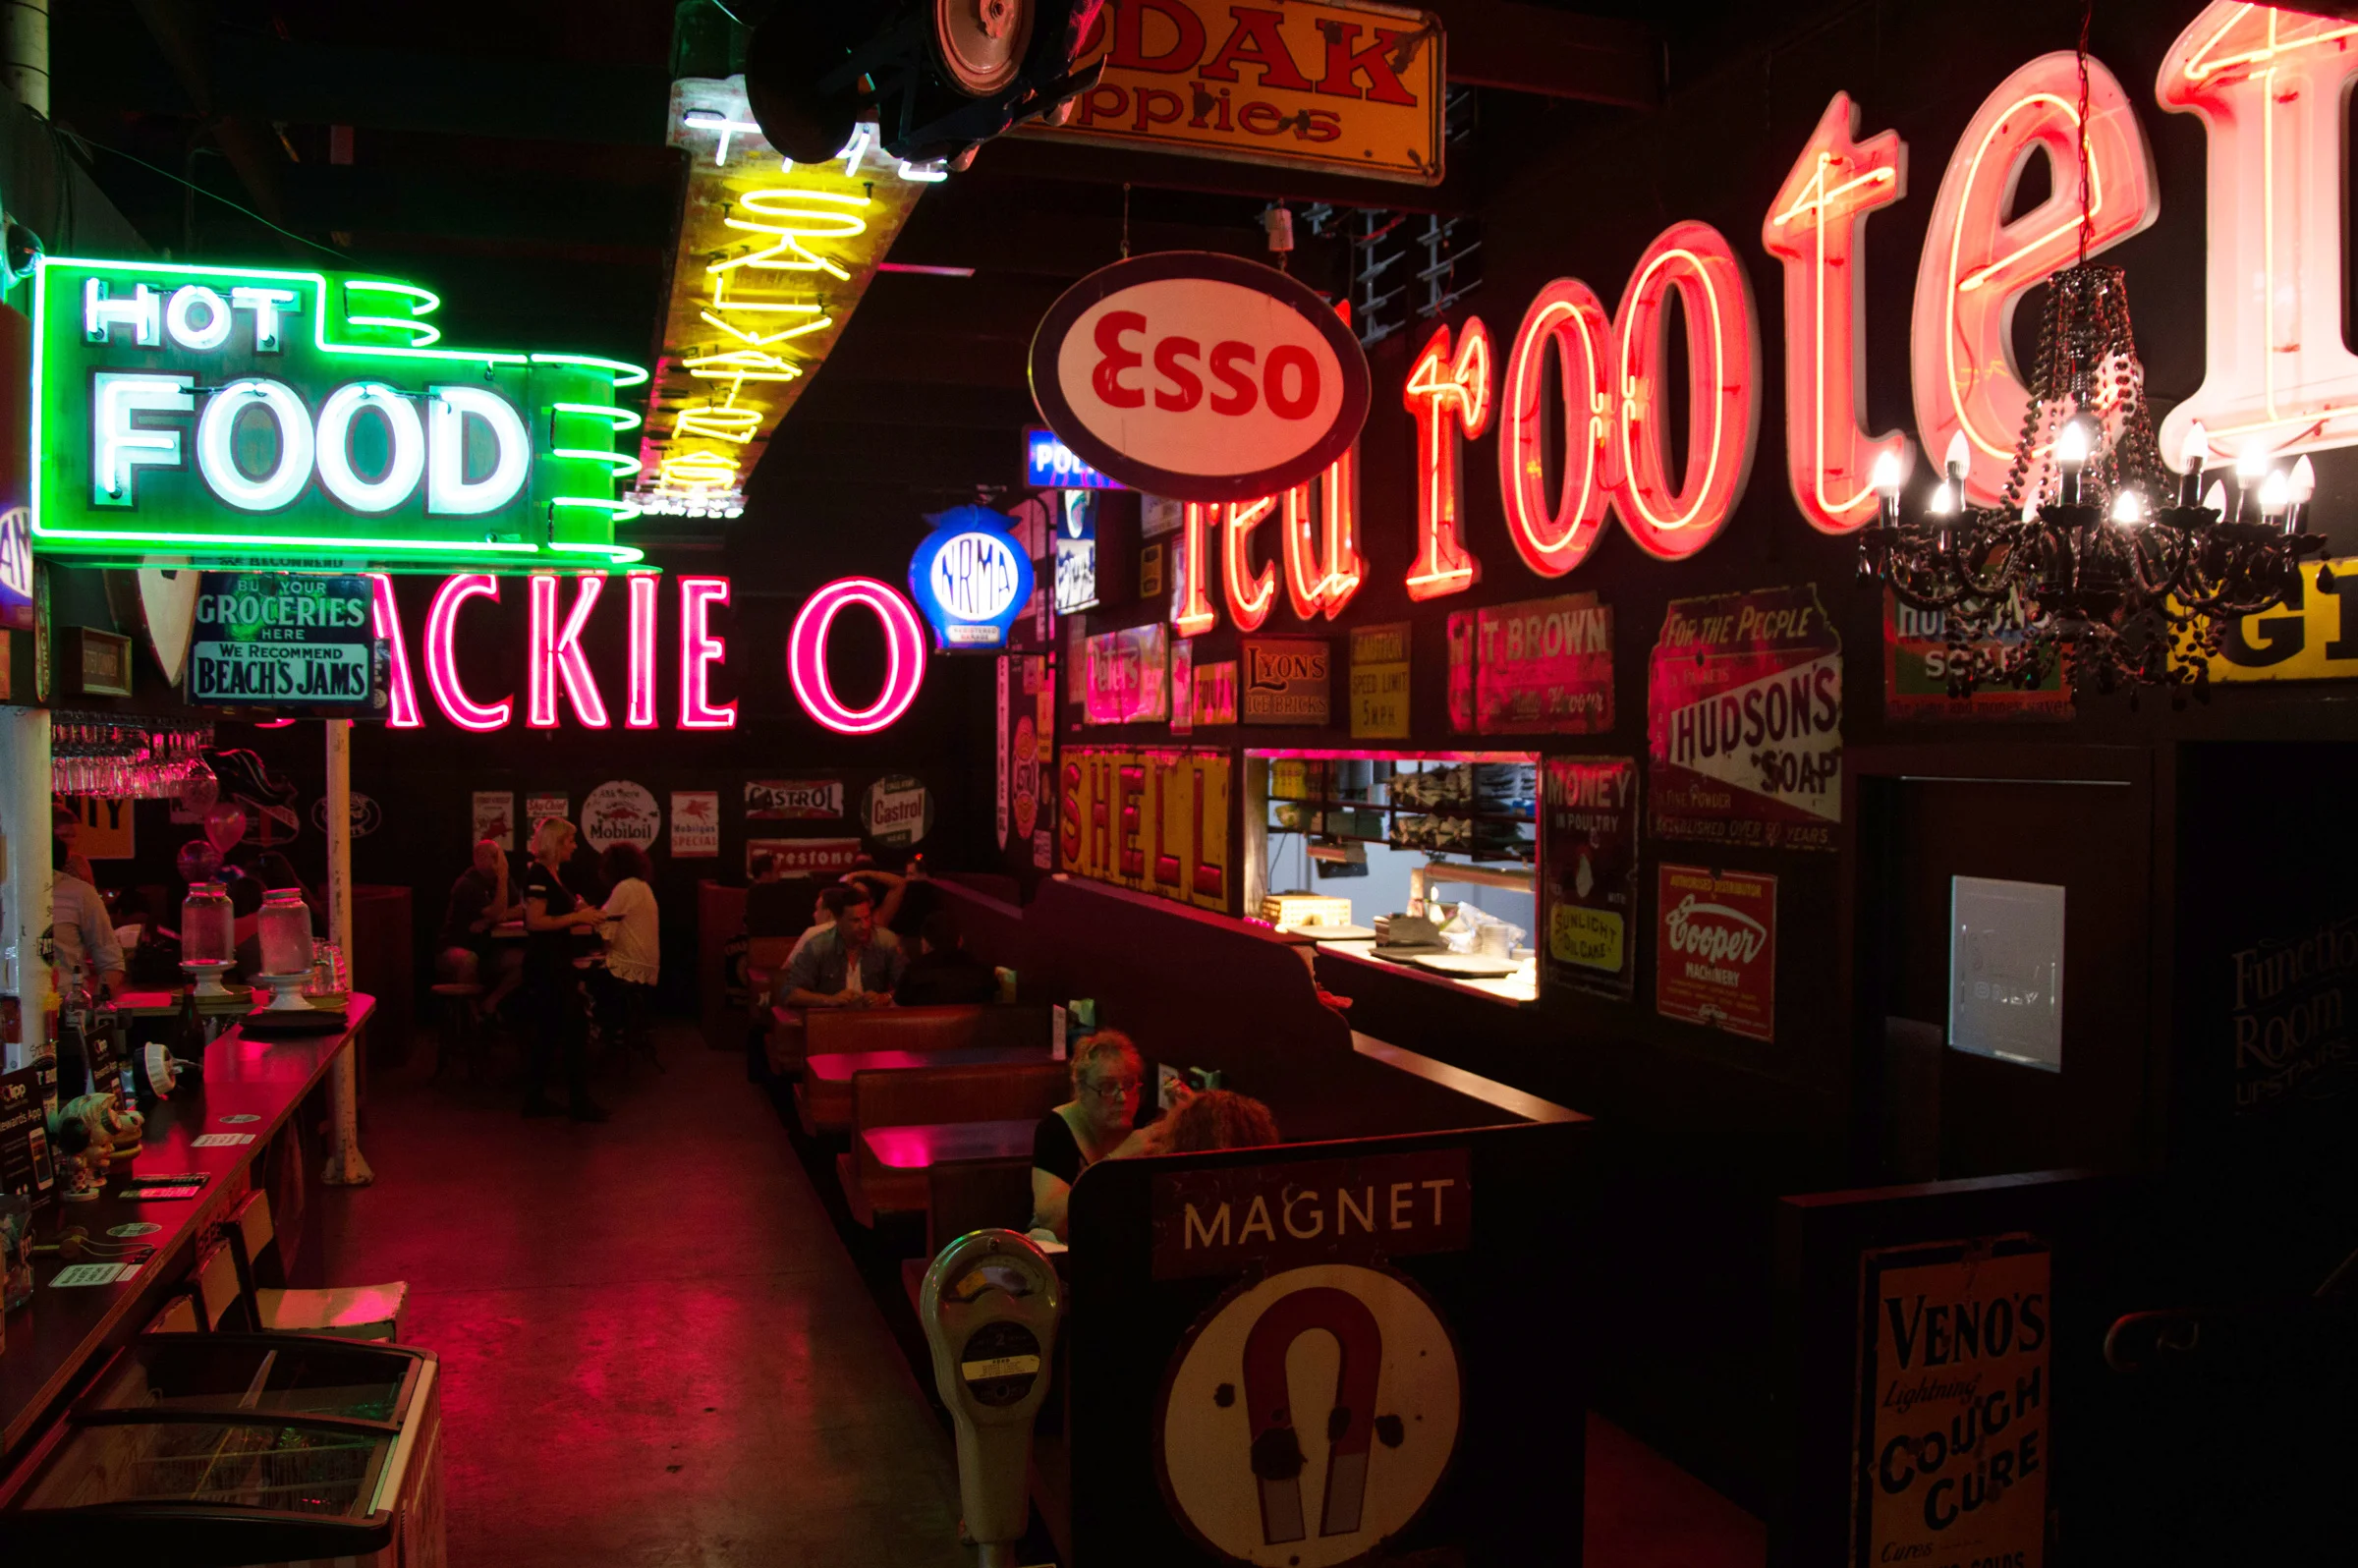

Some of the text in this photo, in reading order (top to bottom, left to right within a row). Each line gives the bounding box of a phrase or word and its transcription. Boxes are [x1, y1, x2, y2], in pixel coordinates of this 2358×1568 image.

[84, 277, 299, 352] HOT
[93, 373, 531, 515] FOOD
[238, 581, 327, 594] BU YOUR
[941, 537, 1010, 614] NRMA
[196, 594, 365, 627] GROCERIES
[261, 629, 306, 640] HERE
[371, 574, 926, 734] ACKIE O
[1506, 608, 1608, 661] BROWN
[197, 657, 294, 695] BEACH'S
[297, 660, 365, 696] JAMS
[751, 786, 838, 813] CASTROL
[874, 794, 923, 824] Castrol
[1547, 769, 1631, 810] MONEY
[590, 823, 651, 840] Mobiloil
[673, 835, 717, 847] SPECIAL
[1062, 762, 1222, 898] SHELL
[1568, 813, 1619, 833] POULTRY
[1665, 893, 1768, 964] Cooper
[2231, 927, 2358, 1012] Functio
[1184, 1179, 1454, 1251] MAGNET
[1883, 1372, 1982, 1410] Lightning
